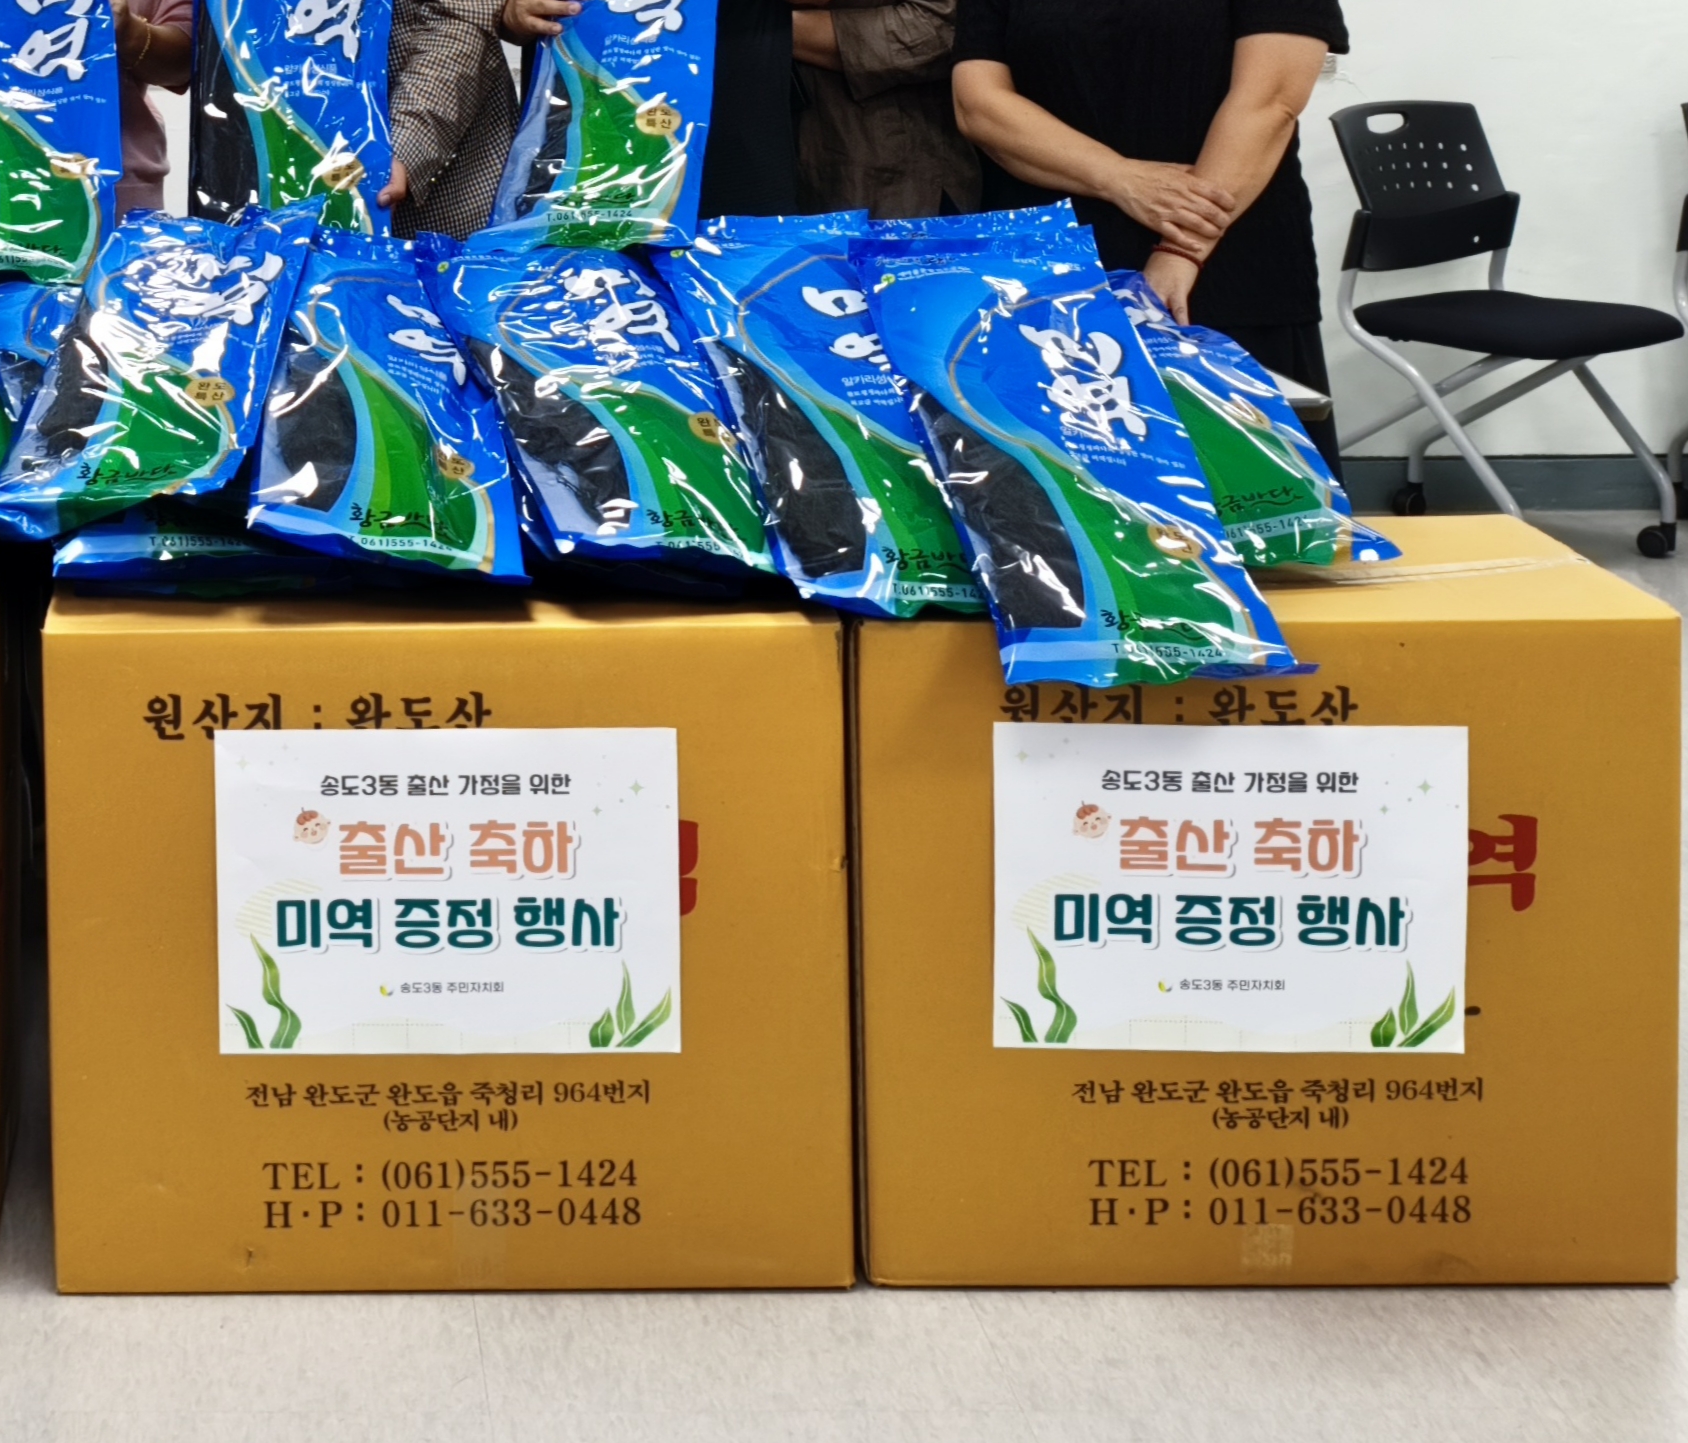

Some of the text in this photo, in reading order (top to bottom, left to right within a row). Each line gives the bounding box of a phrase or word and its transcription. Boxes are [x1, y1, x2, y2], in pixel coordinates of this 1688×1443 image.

[1216, 486, 1304, 516] 금바다
[321, 774, 571, 796] 송도3동 출산 가정을 위한
[1102, 770, 1359, 793] 송도3동 출산 가정을 위한
[339, 820, 573, 875] 출산 축하
[1119, 816, 1360, 873] 출산 축하
[276, 897, 619, 949] 미역 증정 행사
[1054, 894, 1405, 946] 미역 증정 행사
[401, 982, 504, 993] 송도3동 주민자치회
[1180, 979, 1285, 991] 송도3동 주민자치회
[245, 1079, 649, 1111] 전남 완도군 완도읍 죽청리 964번지
[1071, 1077, 1482, 1104] 전남 완도군 완도읍 죽청리 964번지
[383, 1108, 517, 1131] (농공단지 내)
[1212, 1102, 1349, 1129] (농공단지 내)
[382, 1159, 637, 1191] (061)555-1424
[1210, 1157, 1468, 1193] (061)555-1424
[382, 1197, 640, 1227] 011-633-0448
[1209, 1192, 1470, 1225] 011-633-0448
